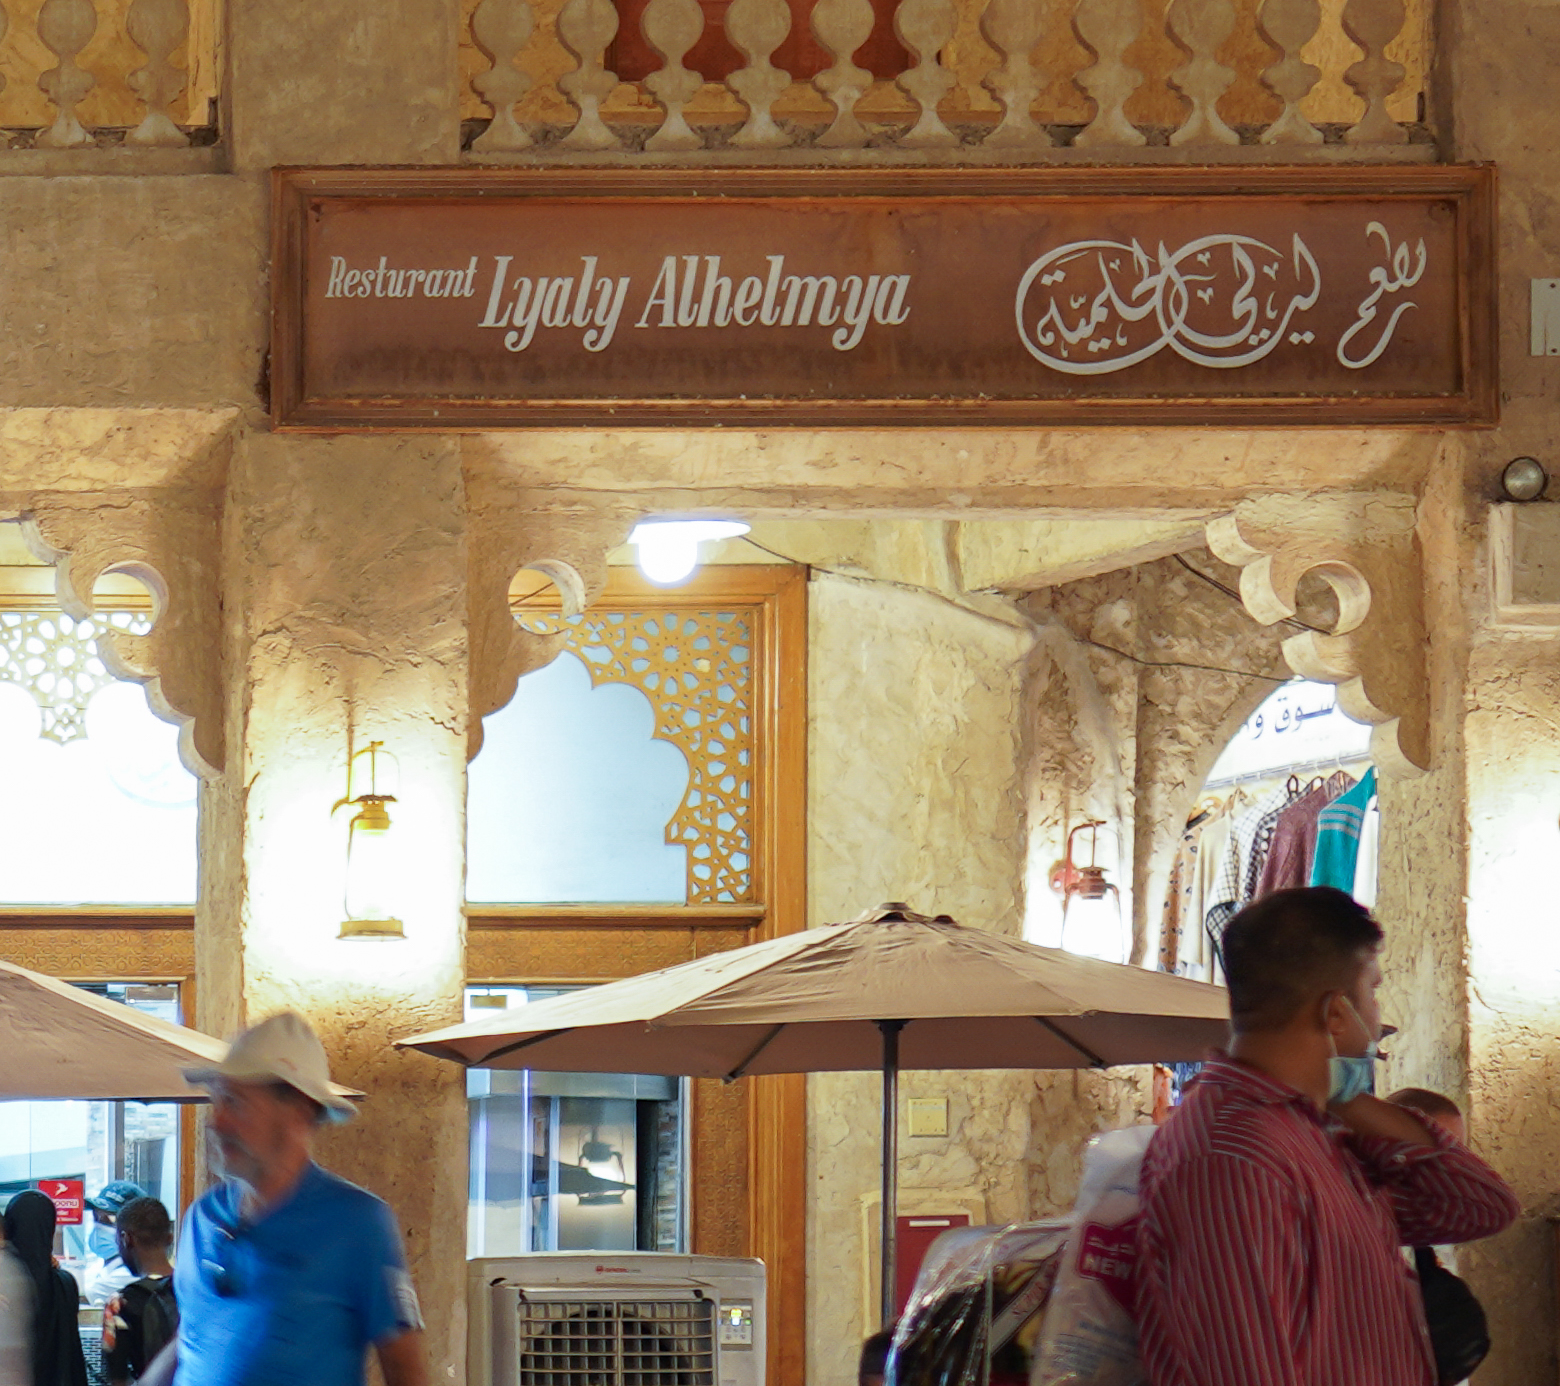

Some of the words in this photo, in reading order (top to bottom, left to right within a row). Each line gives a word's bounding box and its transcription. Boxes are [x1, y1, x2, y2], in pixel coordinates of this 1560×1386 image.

[325, 255, 478, 300] Resturant
[478, 255, 630, 352] Lyaly
[635, 253, 911, 352] Alhelmya
